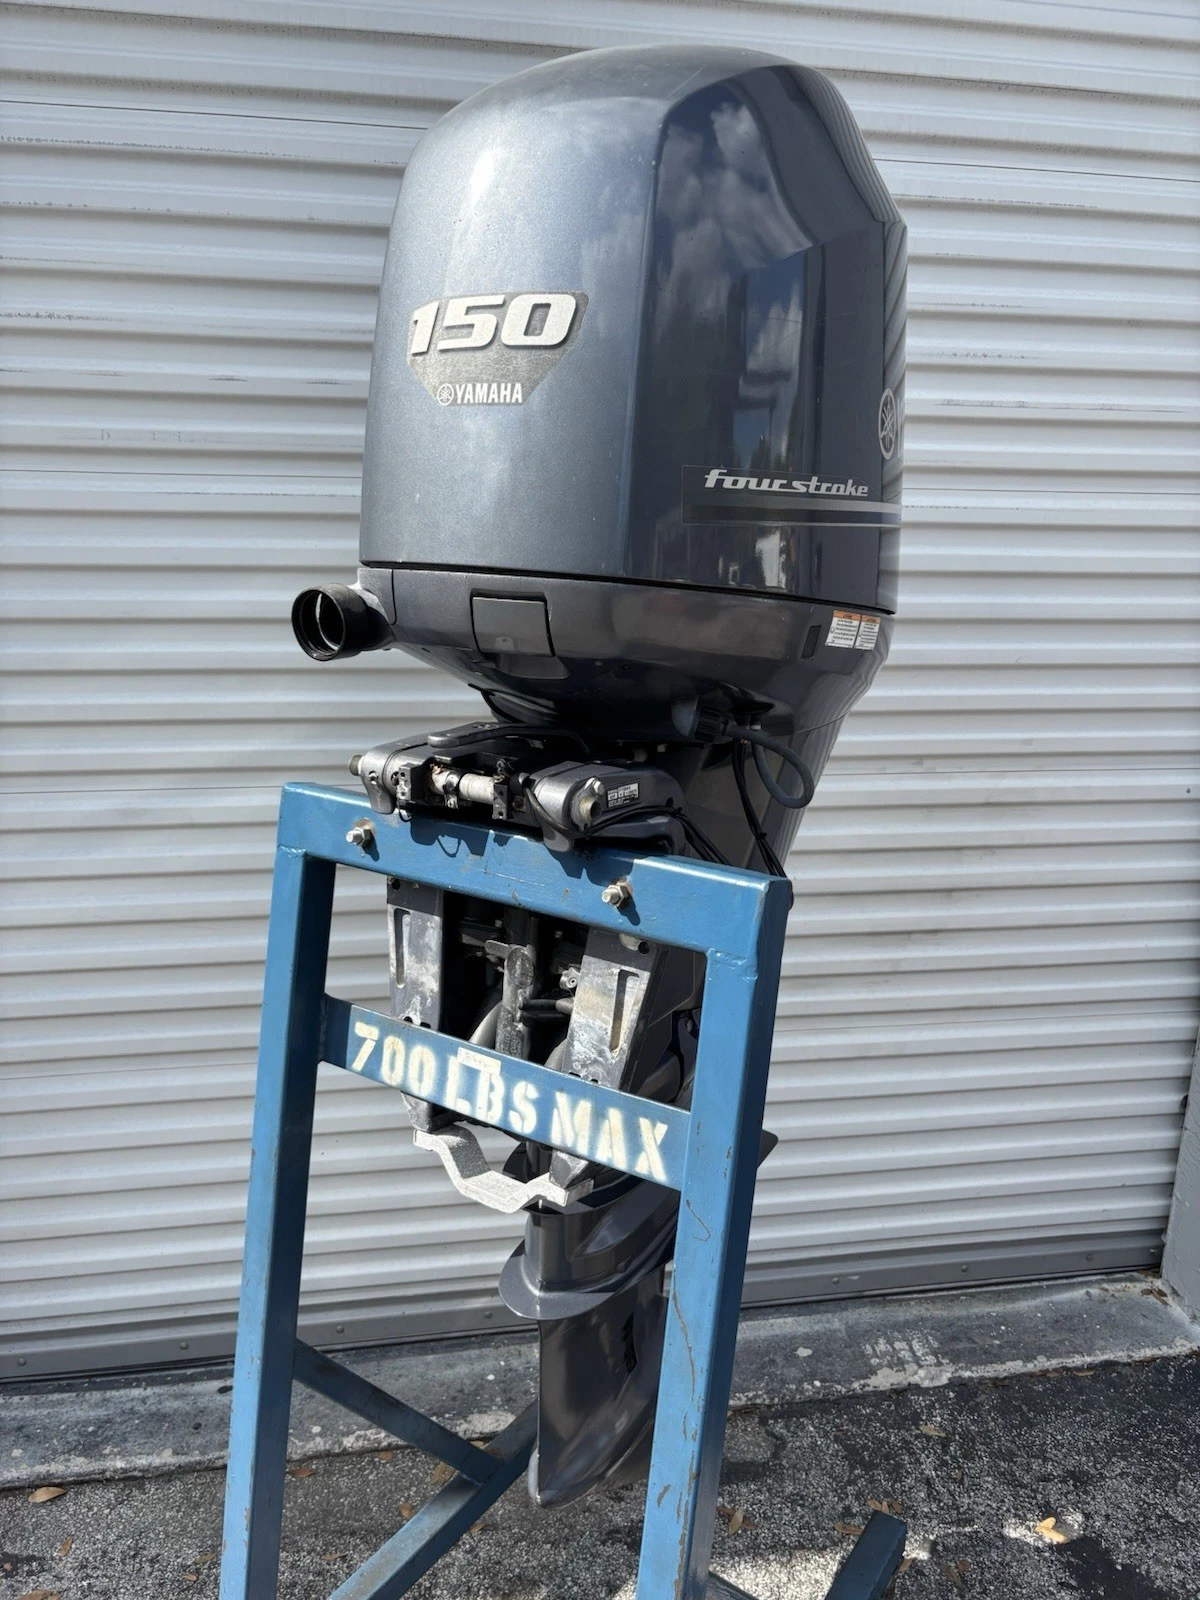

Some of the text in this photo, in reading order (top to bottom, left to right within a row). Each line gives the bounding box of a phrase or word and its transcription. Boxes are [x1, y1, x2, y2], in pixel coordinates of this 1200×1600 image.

[411, 294, 577, 355] 150
[455, 382, 523, 403] YAMAHA
[353, 1022, 668, 1182] 700 LBS MAX
